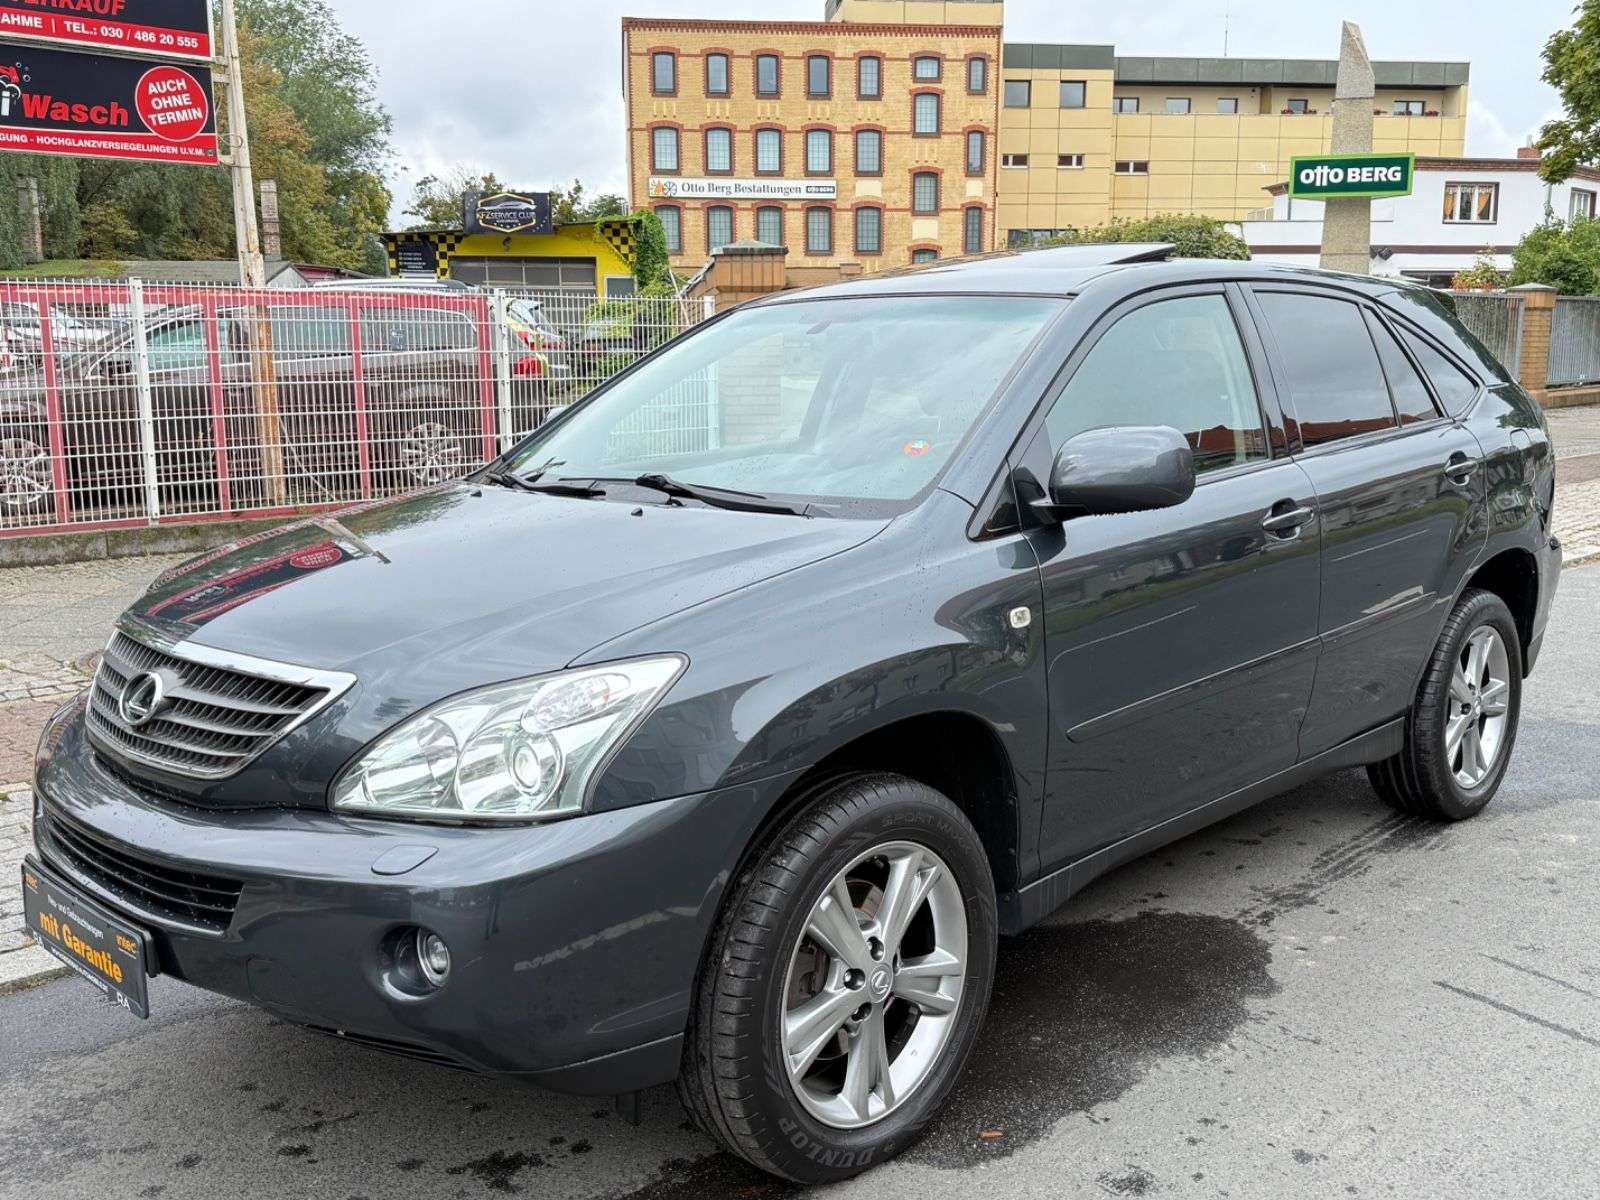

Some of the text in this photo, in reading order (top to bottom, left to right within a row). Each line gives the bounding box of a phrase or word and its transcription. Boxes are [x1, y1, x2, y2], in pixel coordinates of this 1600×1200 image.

[63, 20, 97, 35] TEL.:
[100, 26, 123, 38] 030
[134, 31, 156, 42] 486
[159, 34, 174, 45] 20
[177, 37, 199, 48] 555
[148, 78, 187, 95] AUCH
[22, 93, 129, 126] Wasch
[151, 93, 192, 110] OHNE
[148, 107, 203, 126] TERMIN
[36, 135, 178, 154] HOCHGLANZVERSIEGELUNGEN
[1346, 166, 1402, 183] BERG
[681, 182, 705, 194] Otto
[707, 182, 732, 195] Berg
[734, 183, 802, 196] Bestattungen
[39, 911, 61, 941] mit
[62, 923, 124, 984] Garantie
[777, 1116, 875, 1168] DUNLOP
